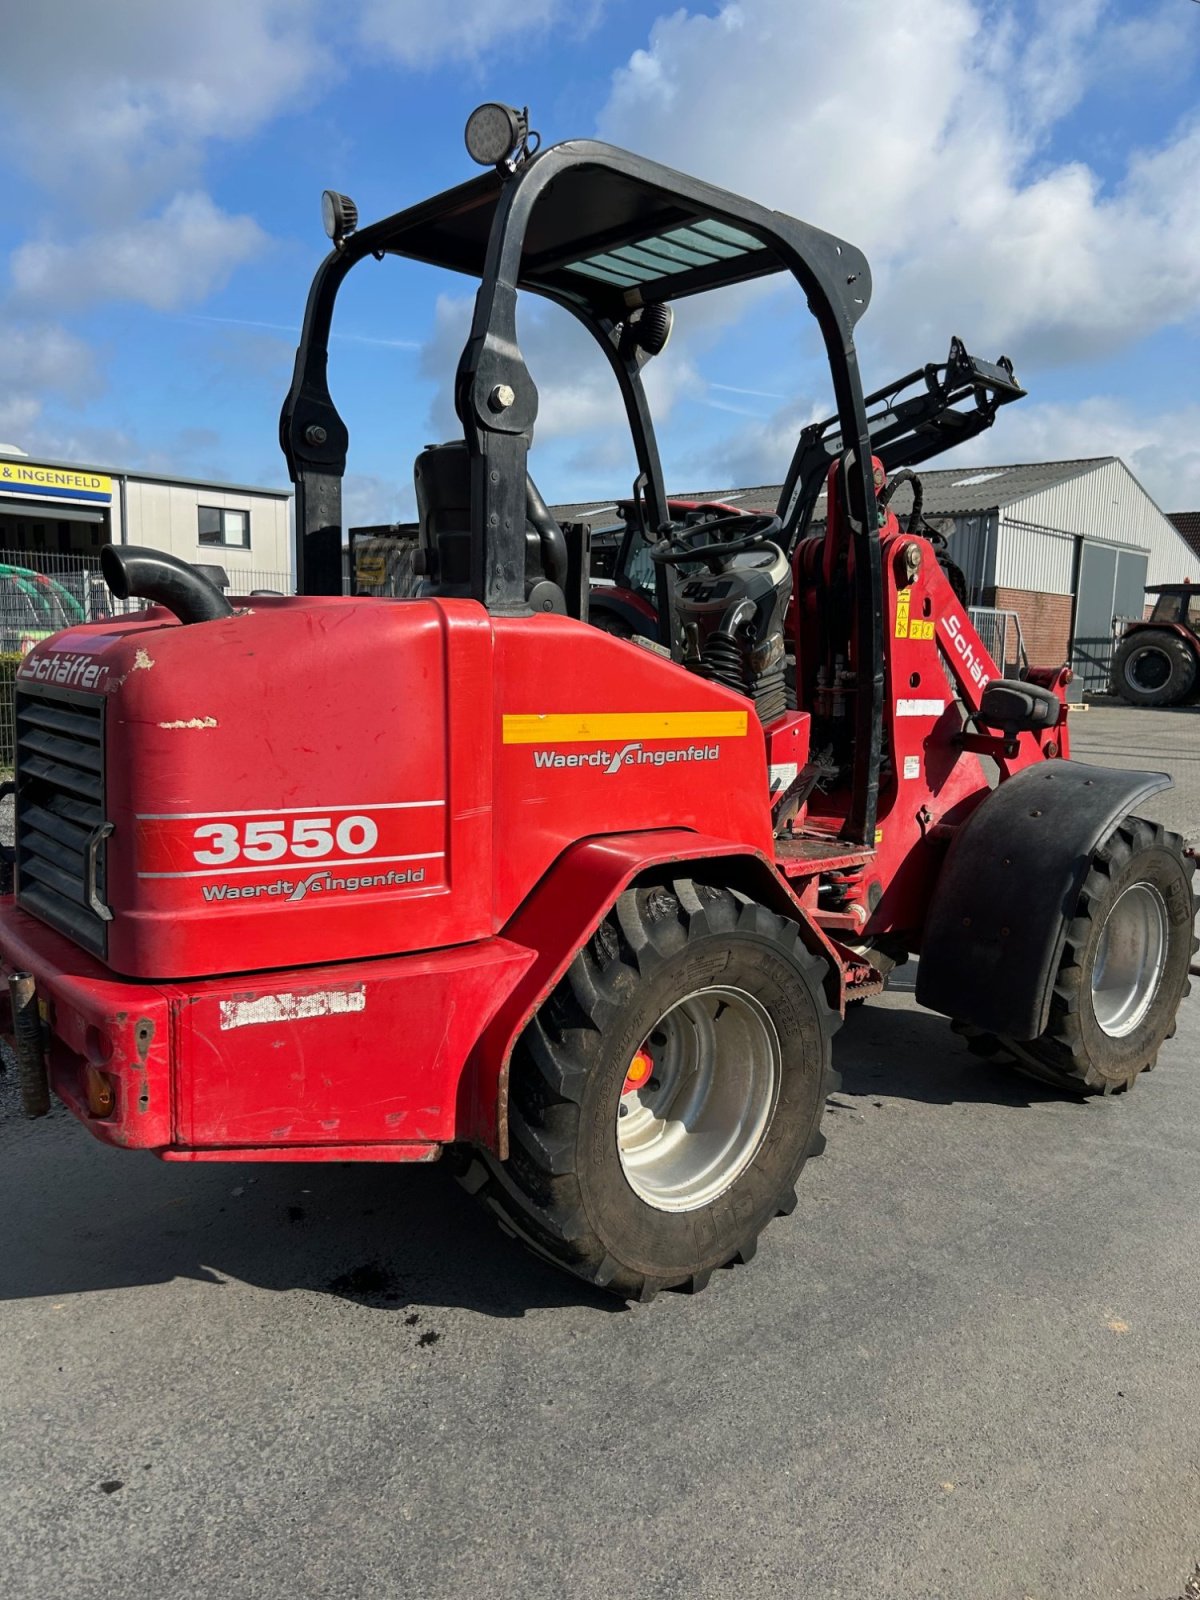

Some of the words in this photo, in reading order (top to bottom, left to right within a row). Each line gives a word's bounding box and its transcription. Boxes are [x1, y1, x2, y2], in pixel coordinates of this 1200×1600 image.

[2, 467, 13, 478] &
[17, 468, 101, 488] INGENFELD
[20, 652, 110, 689] Schäffer
[533, 749, 611, 768] Waerdt
[636, 745, 720, 767] Ingenfeld
[193, 815, 378, 865] 3550
[202, 880, 294, 902] Waerdt
[324, 868, 425, 891] Ingenfeld
